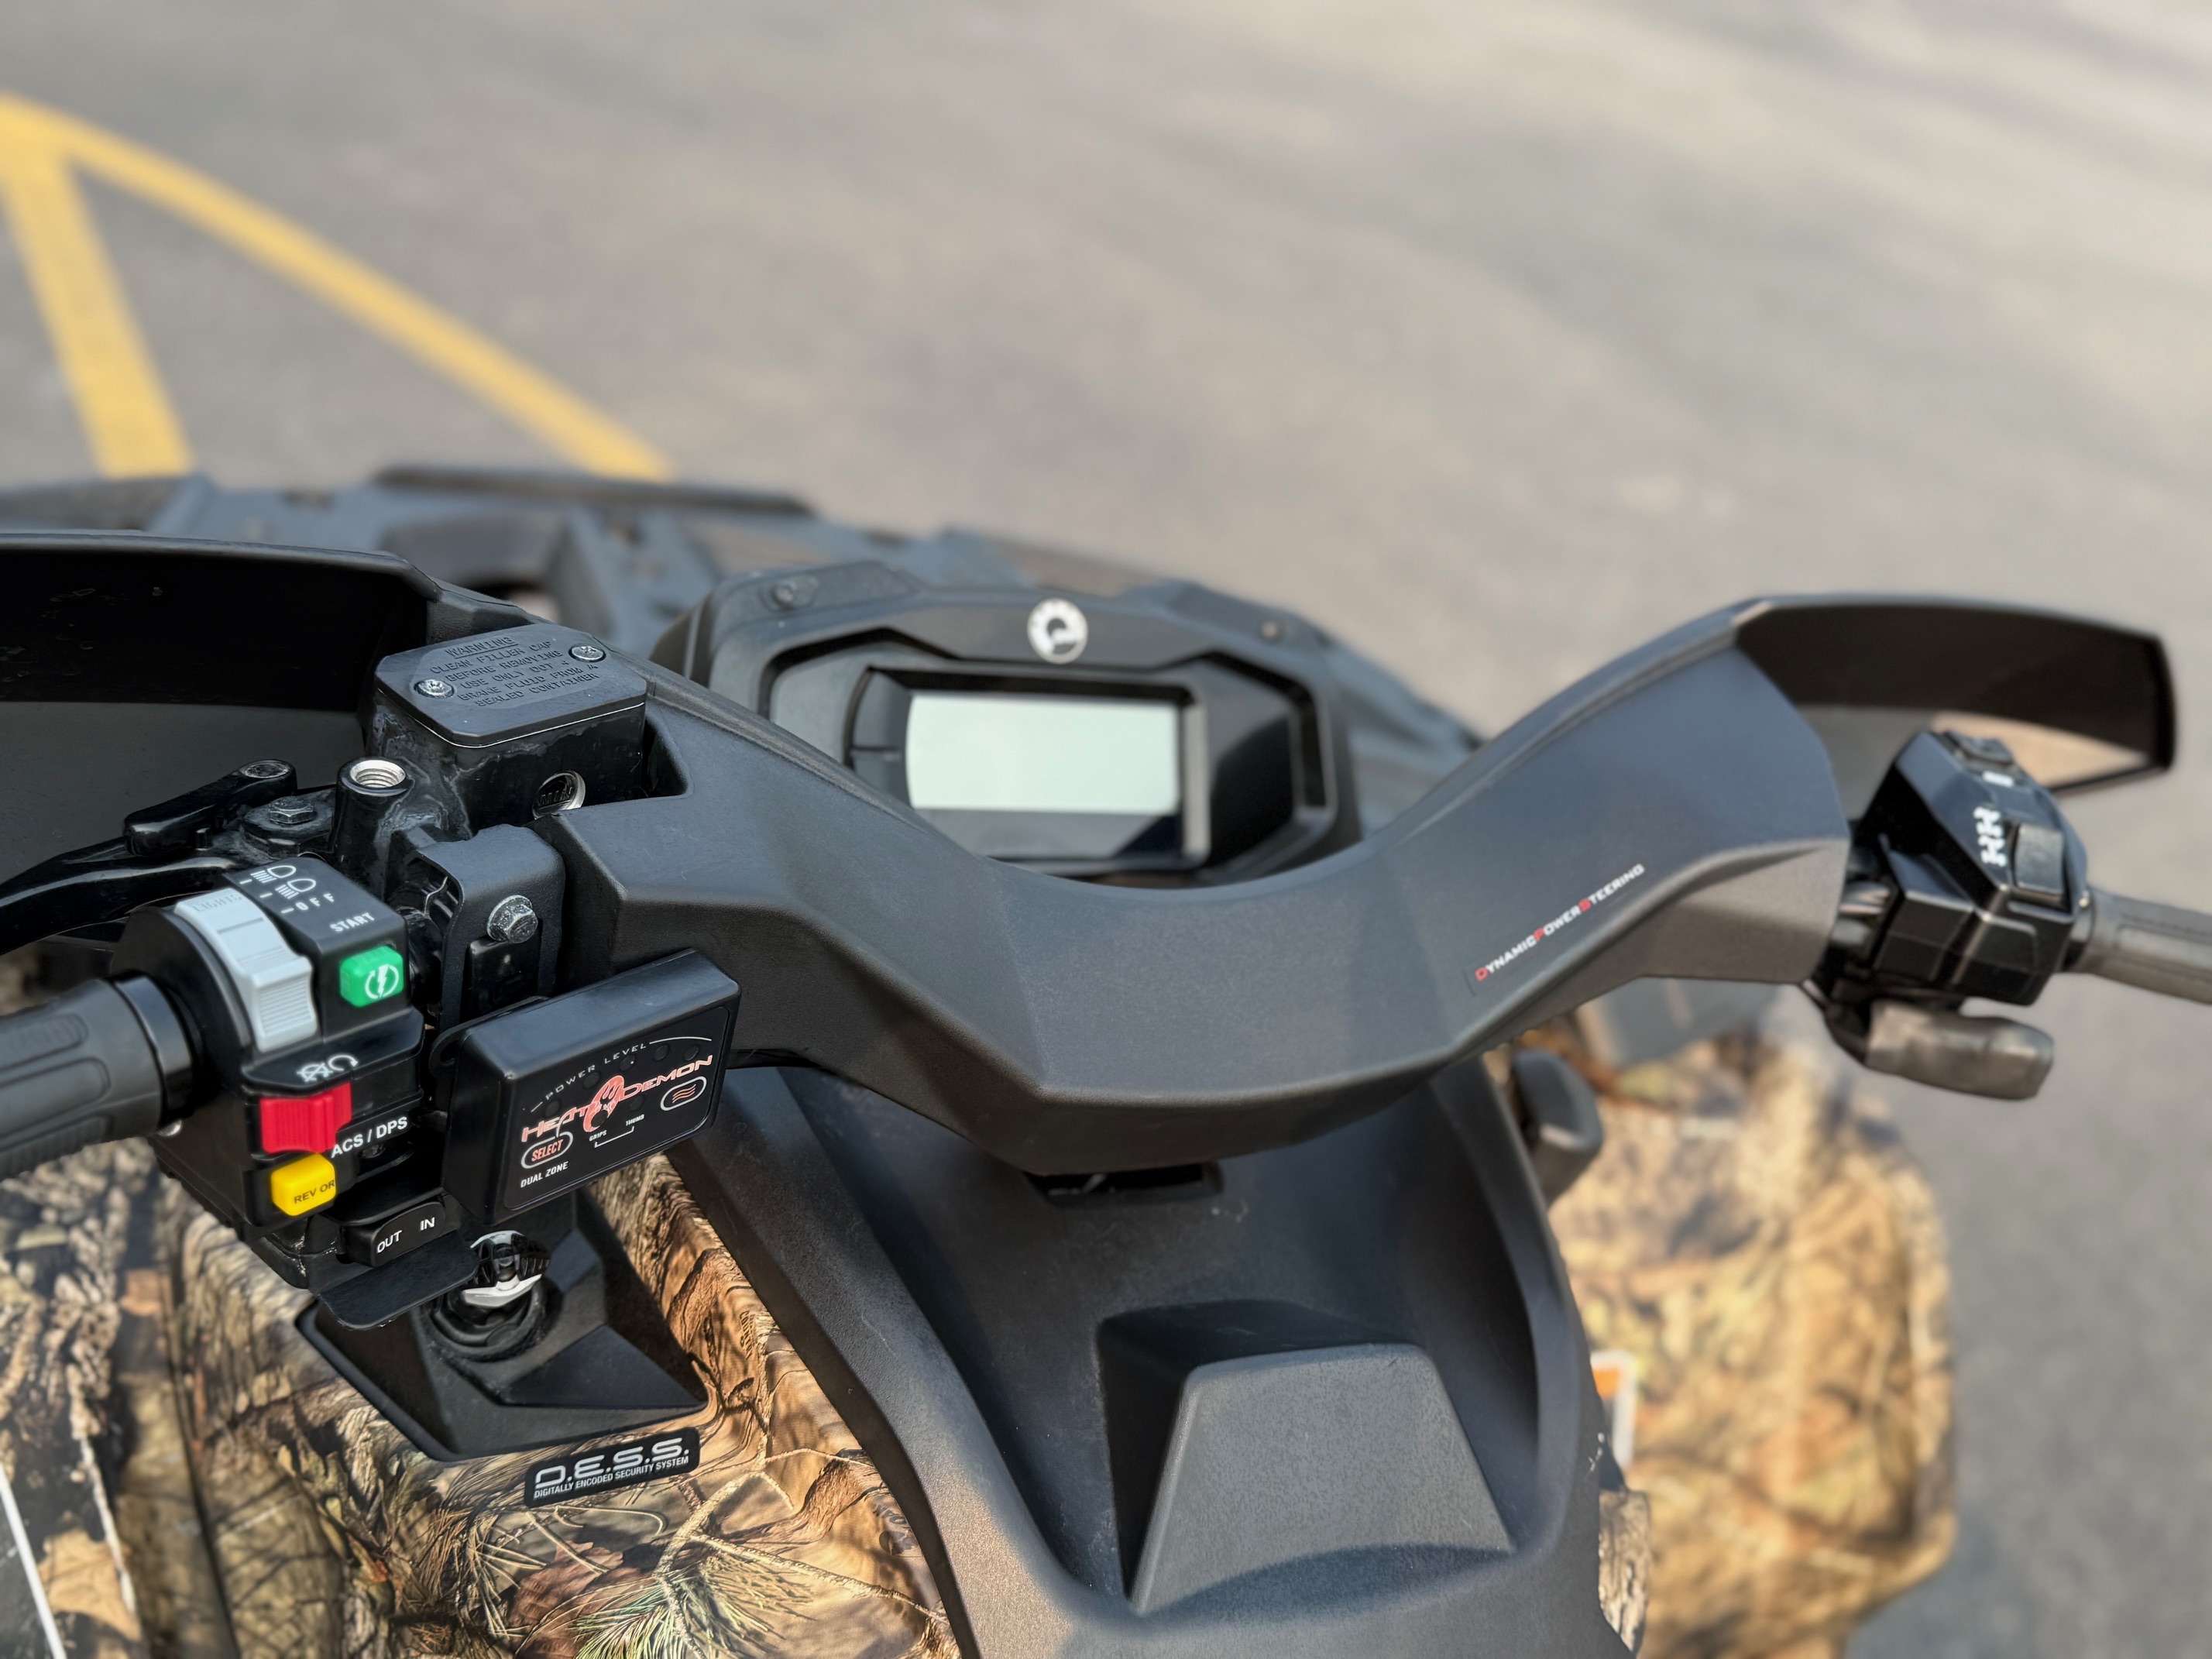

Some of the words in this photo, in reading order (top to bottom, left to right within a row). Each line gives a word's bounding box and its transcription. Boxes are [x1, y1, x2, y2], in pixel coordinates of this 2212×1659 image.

[430, 660, 473, 674] CLEAN
[478, 647, 525, 663] FILLER
[529, 641, 551, 651] CAP
[445, 637, 514, 657] WARNING
[445, 666, 496, 682] BEFORE
[500, 650, 564, 669] REMOVING
[460, 678, 489, 689] USE
[492, 671, 524, 682] ONLY
[529, 662, 554, 673] DOT
[457, 686, 502, 701] BRAKE
[505, 675, 546, 690] FLUID
[551, 667, 583, 679] FROM
[475, 691, 525, 707] SEALED
[529, 673, 599, 694] CONTAINER
[193, 893, 243, 912] LIGHTS
[295, 892, 335, 912] OFF
[330, 912, 376, 933] START
[545, 1065, 596, 1101] POWER
[604, 1043, 647, 1064] LEVEL
[521, 1104, 590, 1142] HEAT
[619, 1054, 713, 1102] DEMON
[331, 1133, 364, 1159] ACS
[376, 1115, 408, 1139] DPS
[589, 1130, 607, 1142] GRIPS
[531, 1139, 564, 1162] SELECT
[520, 1172, 543, 1188] DUAL
[544, 1161, 569, 1177] ZONE
[294, 1187, 318, 1204] REV
[320, 1180, 335, 1193] OR
[420, 1217, 435, 1231] IN
[376, 1230, 402, 1253] OUT
[534, 1481, 575, 1499] DIGITALLY
[575, 1473, 613, 1489] ENCODED
[615, 1462, 654, 1479] SECURITY
[655, 1455, 689, 1471] SYSTEM
